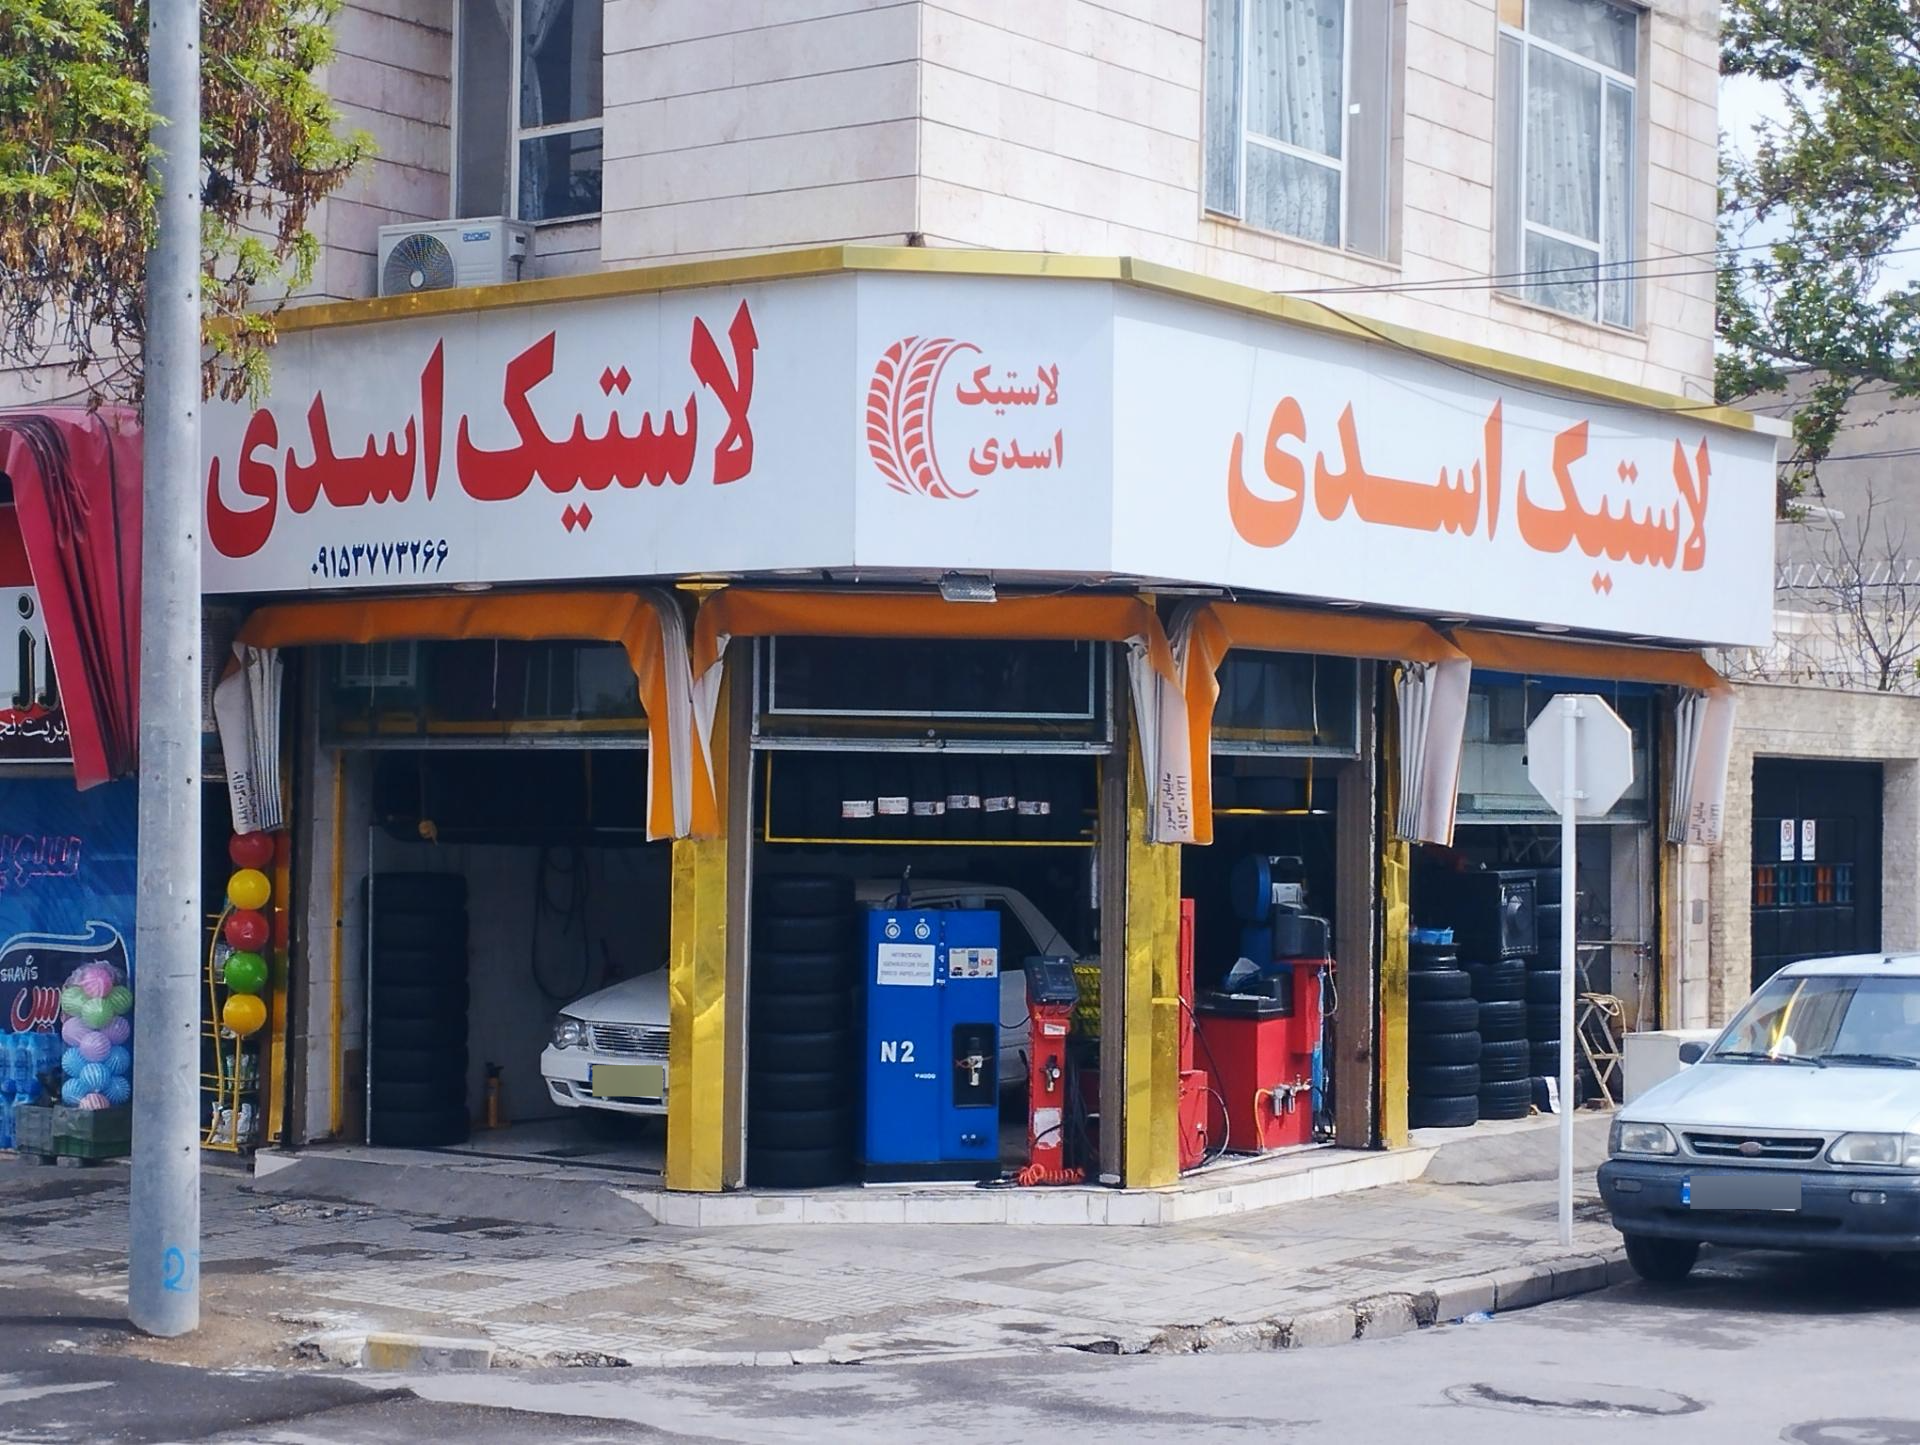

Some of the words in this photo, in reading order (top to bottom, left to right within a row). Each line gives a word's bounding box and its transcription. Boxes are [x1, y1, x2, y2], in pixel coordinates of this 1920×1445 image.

[456, 298, 759, 533] لاستیک
[956, 362, 1060, 416] لاستیک
[207, 336, 444, 558] اسدی
[969, 428, 1063, 476] اسدی
[1228, 396, 1502, 549] اسدی
[312, 539, 449, 578] ۰۹۱۵۳۷۷۳۲۶۶
[1516, 418, 1712, 596] لاستیک
[881, 1040, 915, 1063] N2
